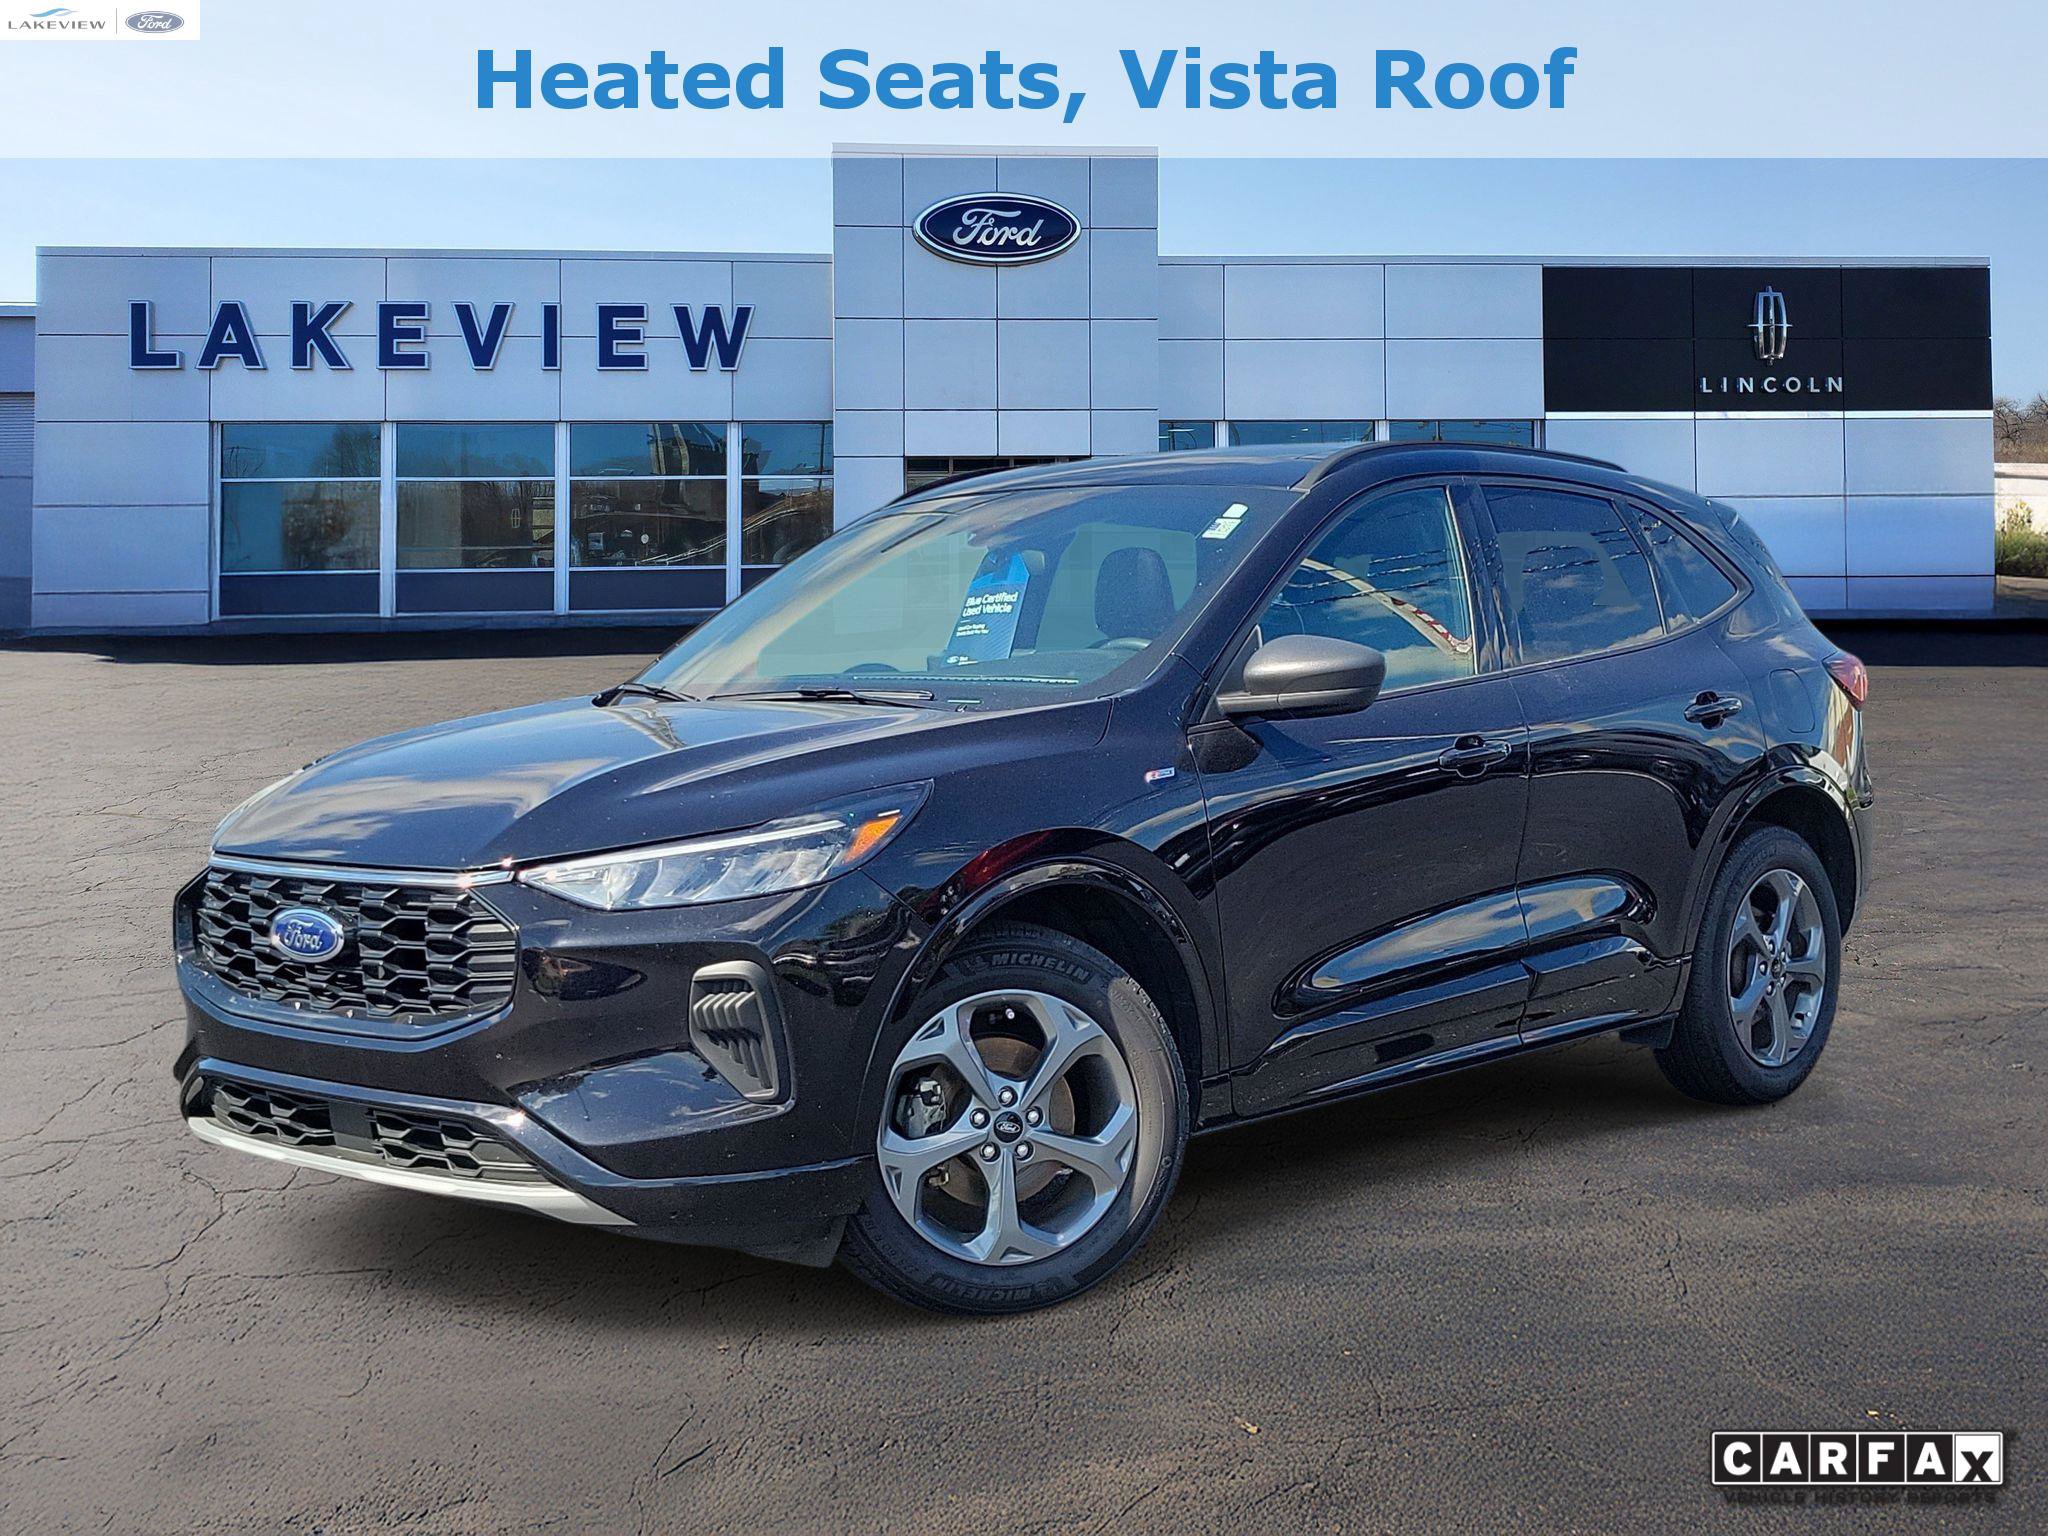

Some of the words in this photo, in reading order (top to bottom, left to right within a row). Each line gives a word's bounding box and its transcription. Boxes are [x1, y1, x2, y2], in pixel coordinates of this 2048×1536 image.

[952, 208, 1044, 247] Ford
[127, 300, 756, 372] LAKEVIEW
[1701, 376, 1843, 394] LINCOLN
[965, 596, 982, 607] Blue
[982, 591, 1019, 604] Certified
[982, 603, 1012, 614] Vehicle
[284, 919, 323, 950] Ford
[991, 953, 1091, 981] MICHELIN
